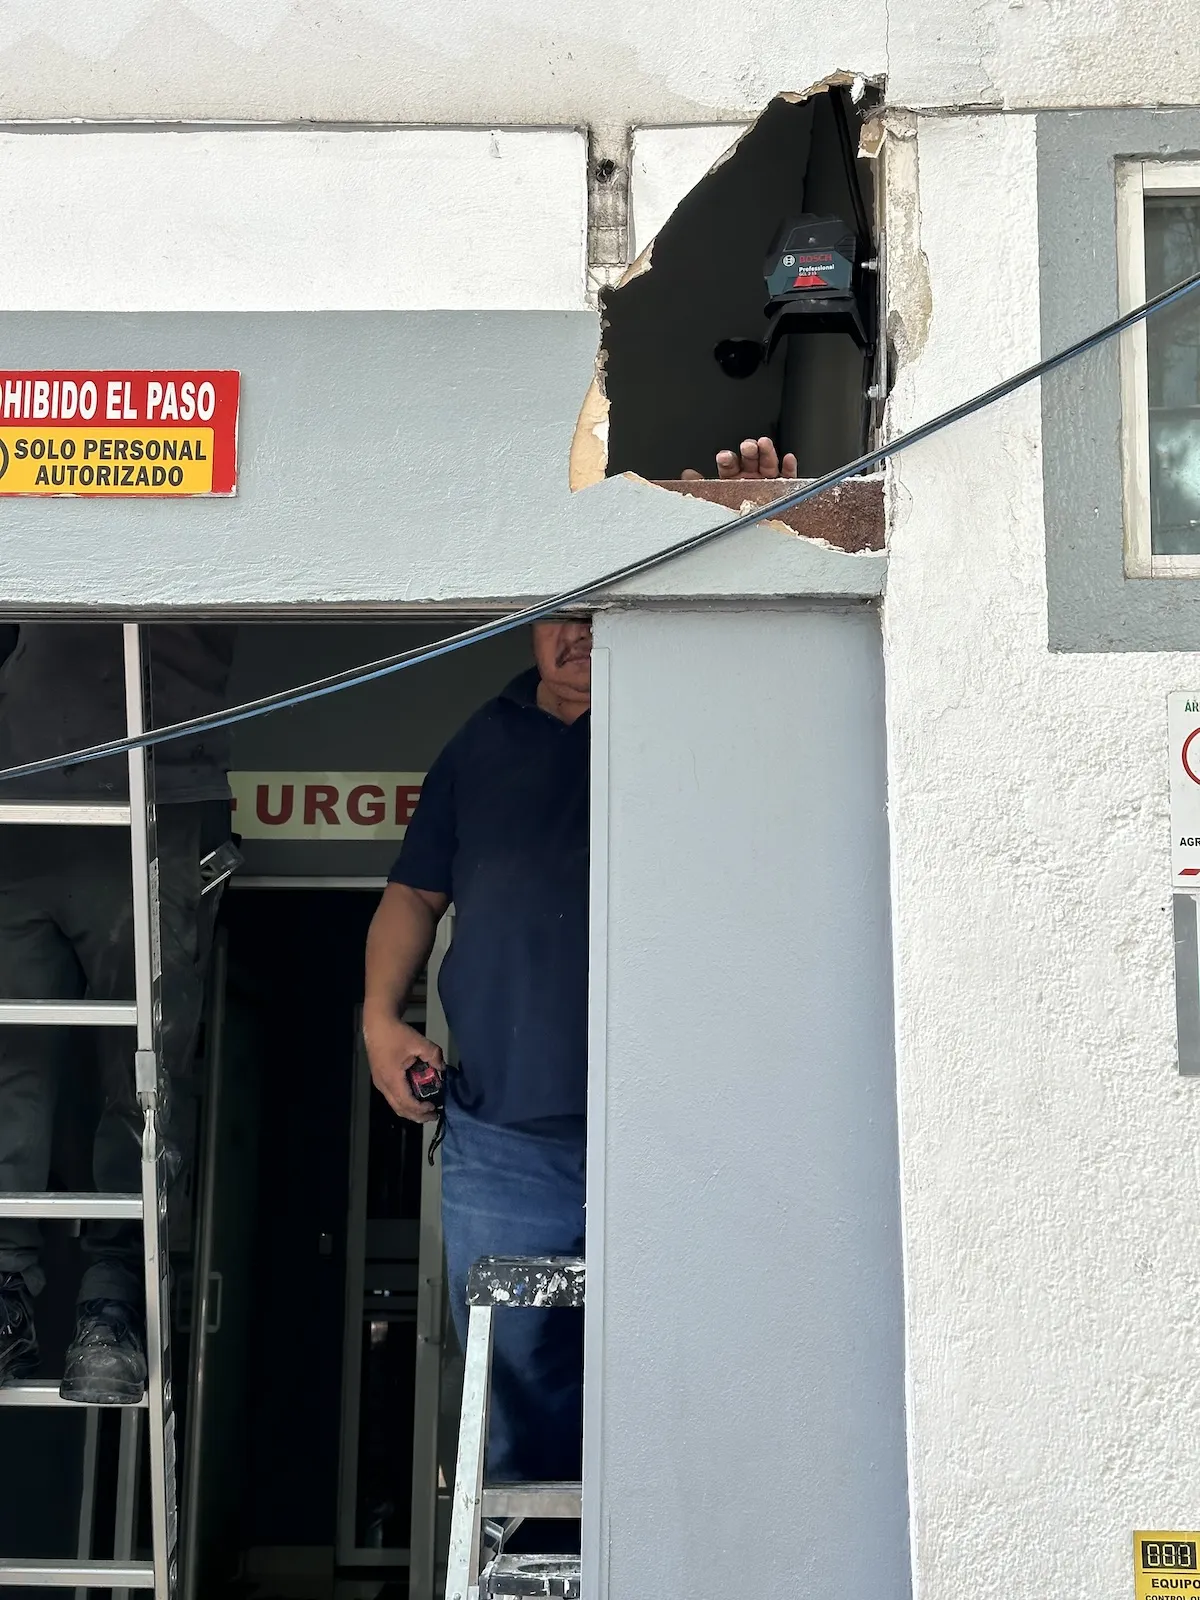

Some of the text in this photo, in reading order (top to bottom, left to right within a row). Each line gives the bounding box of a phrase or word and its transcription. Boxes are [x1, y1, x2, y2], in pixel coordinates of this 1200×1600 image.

[798, 264, 835, 272] Professional
[799, 254, 832, 263] BOSCH
[0, 380, 216, 421] HIBIDO EL PASO
[14, 438, 207, 461] SOLO PERSONAL
[35, 465, 184, 486] AUTORIZADO
